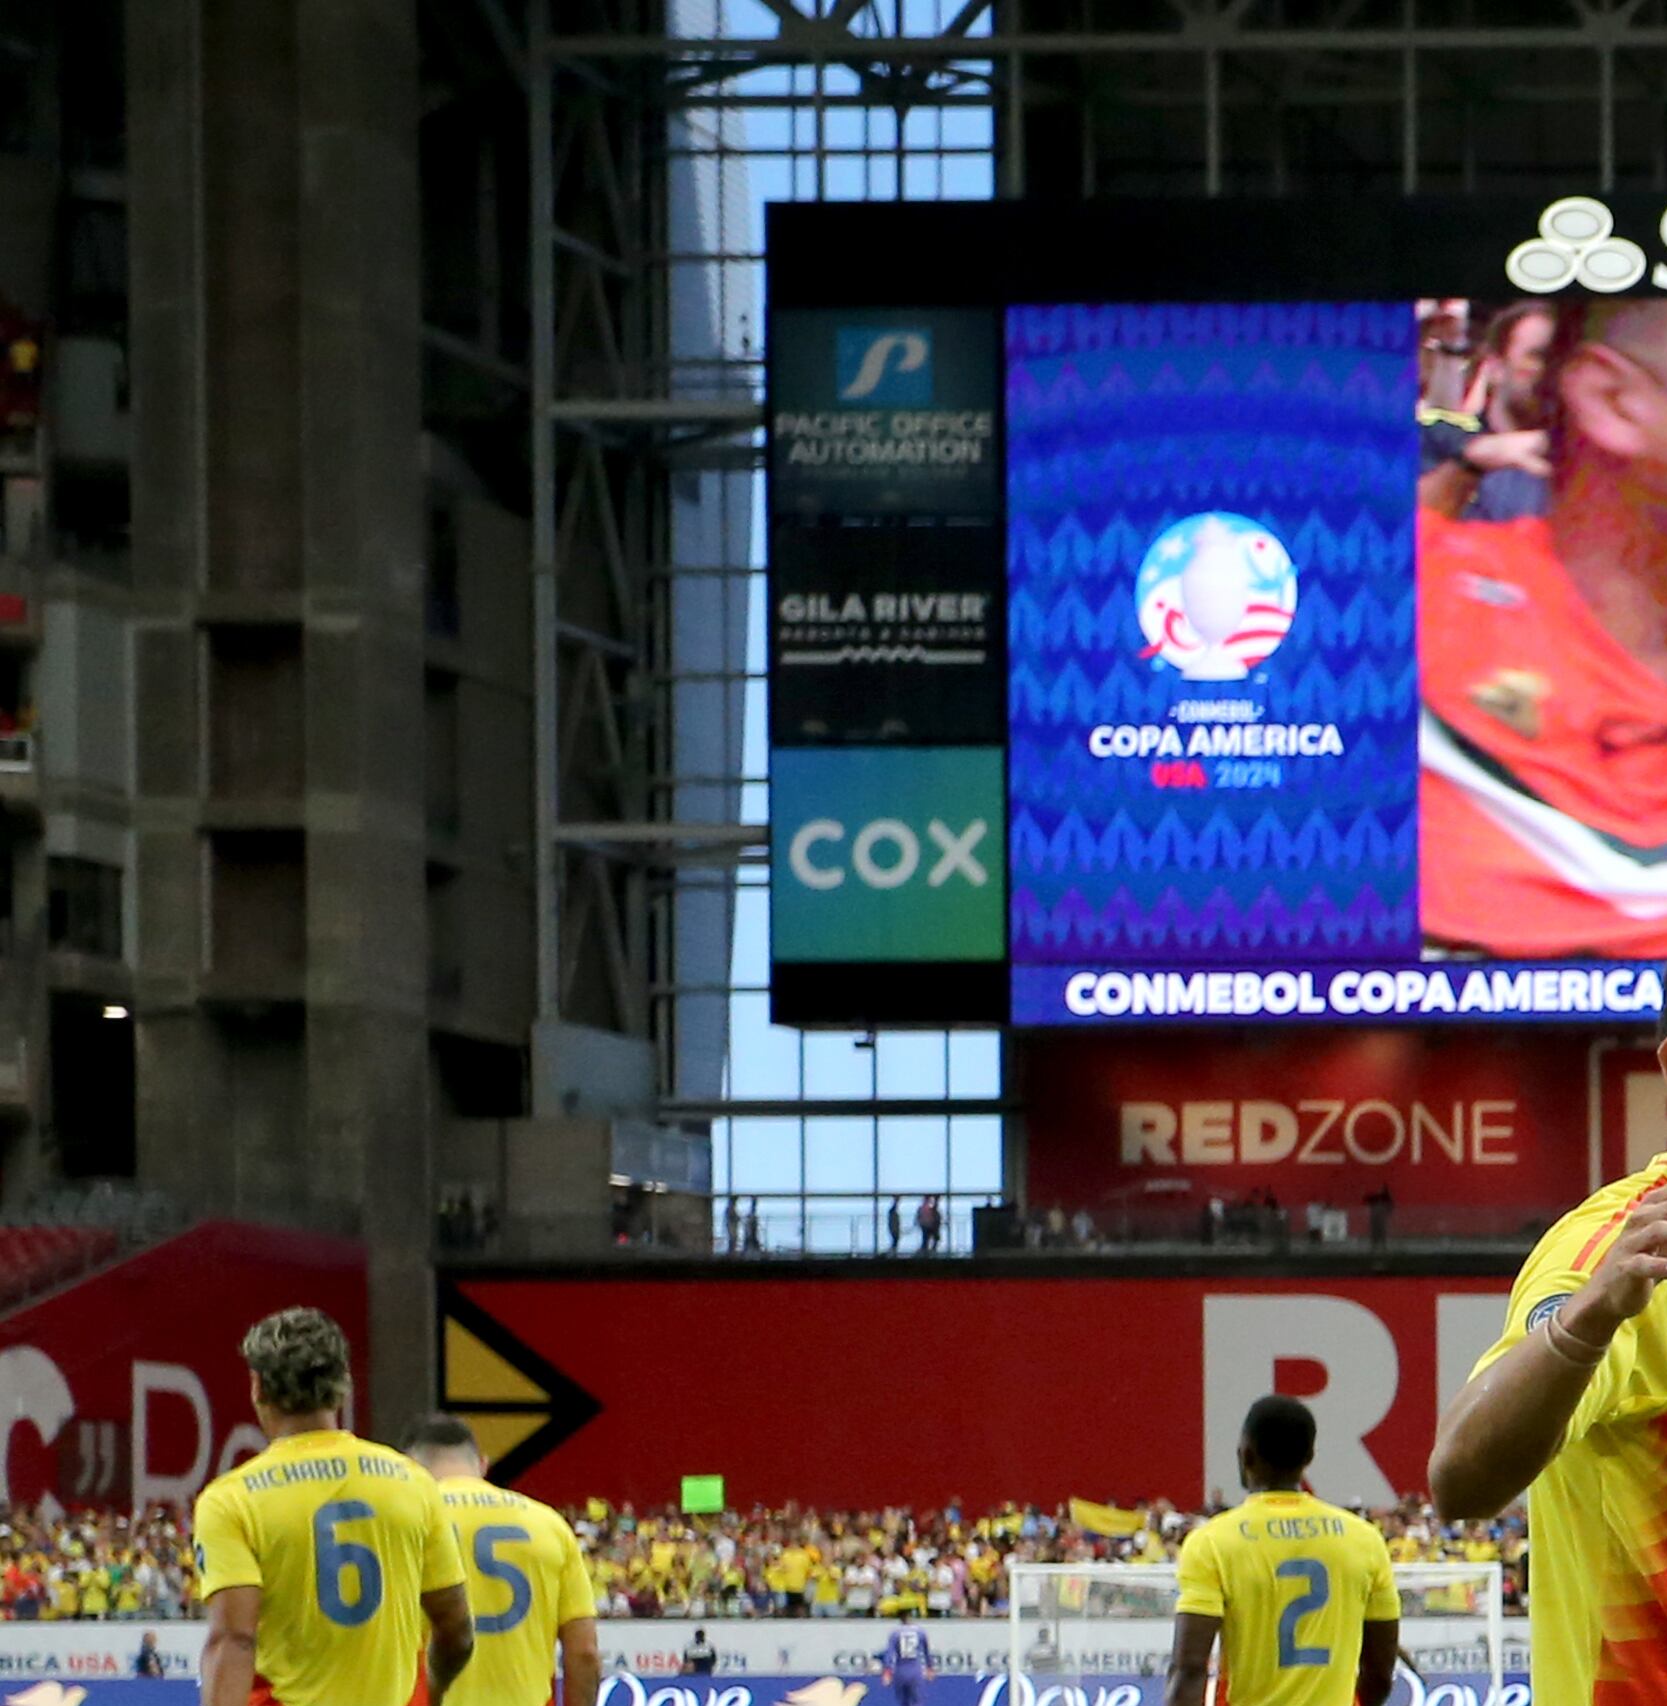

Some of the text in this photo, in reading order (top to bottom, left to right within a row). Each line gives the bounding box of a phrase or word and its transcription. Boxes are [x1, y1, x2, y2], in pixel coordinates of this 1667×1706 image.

[775, 411, 993, 438] PACIFIC OFFICE
[788, 438, 982, 465] AUTOMATION
[780, 593, 984, 623] GILA RIVER
[1089, 724, 1345, 757] COPA AMERICA
[1151, 761, 1281, 788] USA 2024
[789, 818, 989, 890] COX
[1065, 969, 1664, 1016] CONMEBOL COPA AMERICA
[244, 1456, 410, 1493] RICHARD RIOS
[1267, 1517, 1345, 1540] CUESTA
[313, 1499, 382, 1628] 6
[1276, 1557, 1331, 1668] 2
